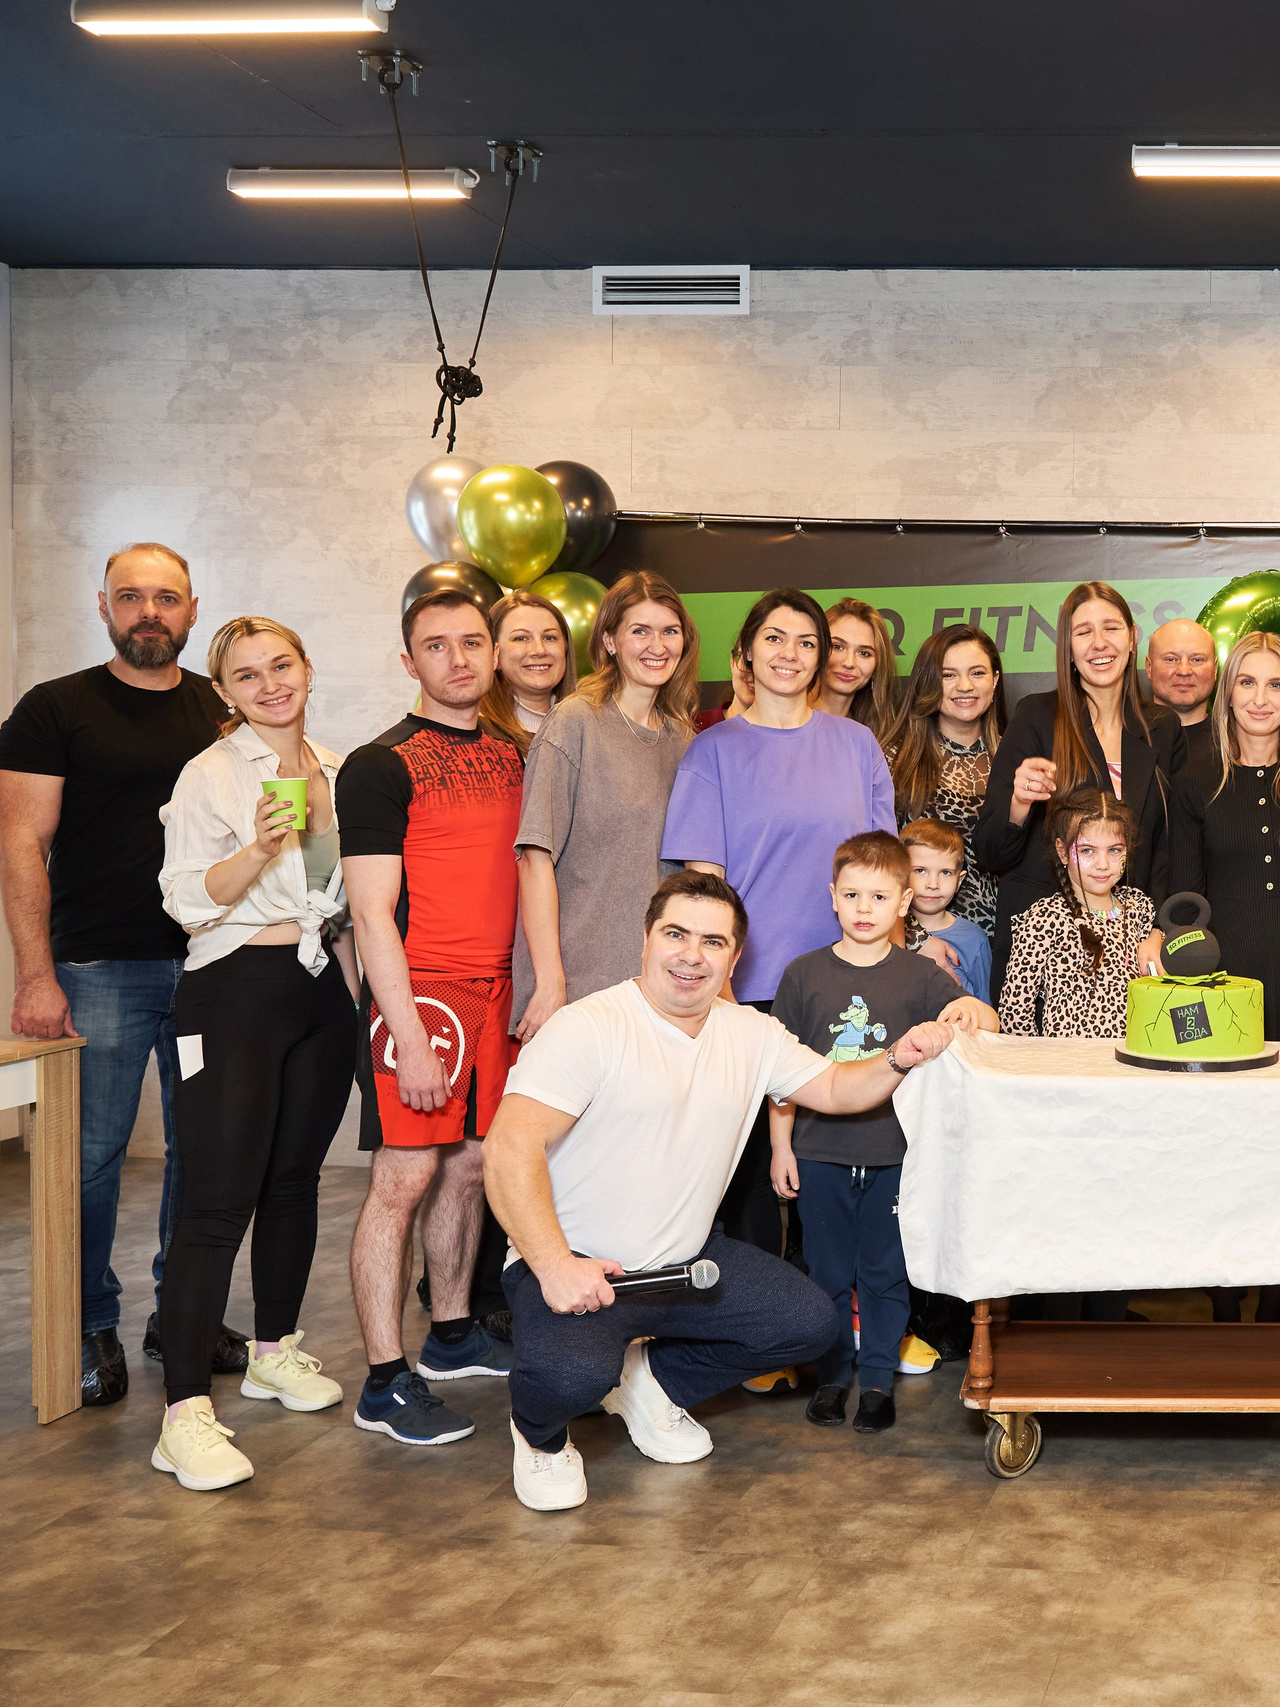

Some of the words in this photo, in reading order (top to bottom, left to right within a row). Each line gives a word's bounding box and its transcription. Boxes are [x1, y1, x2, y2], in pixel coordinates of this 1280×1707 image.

[931, 600, 1186, 654] FITNSS
[1177, 932, 1202, 945] FITNESS
[1177, 1005, 1200, 1019] НАМ
[1187, 1017, 1194, 1028] 2
[1179, 1027, 1208, 1041] ГОДА
